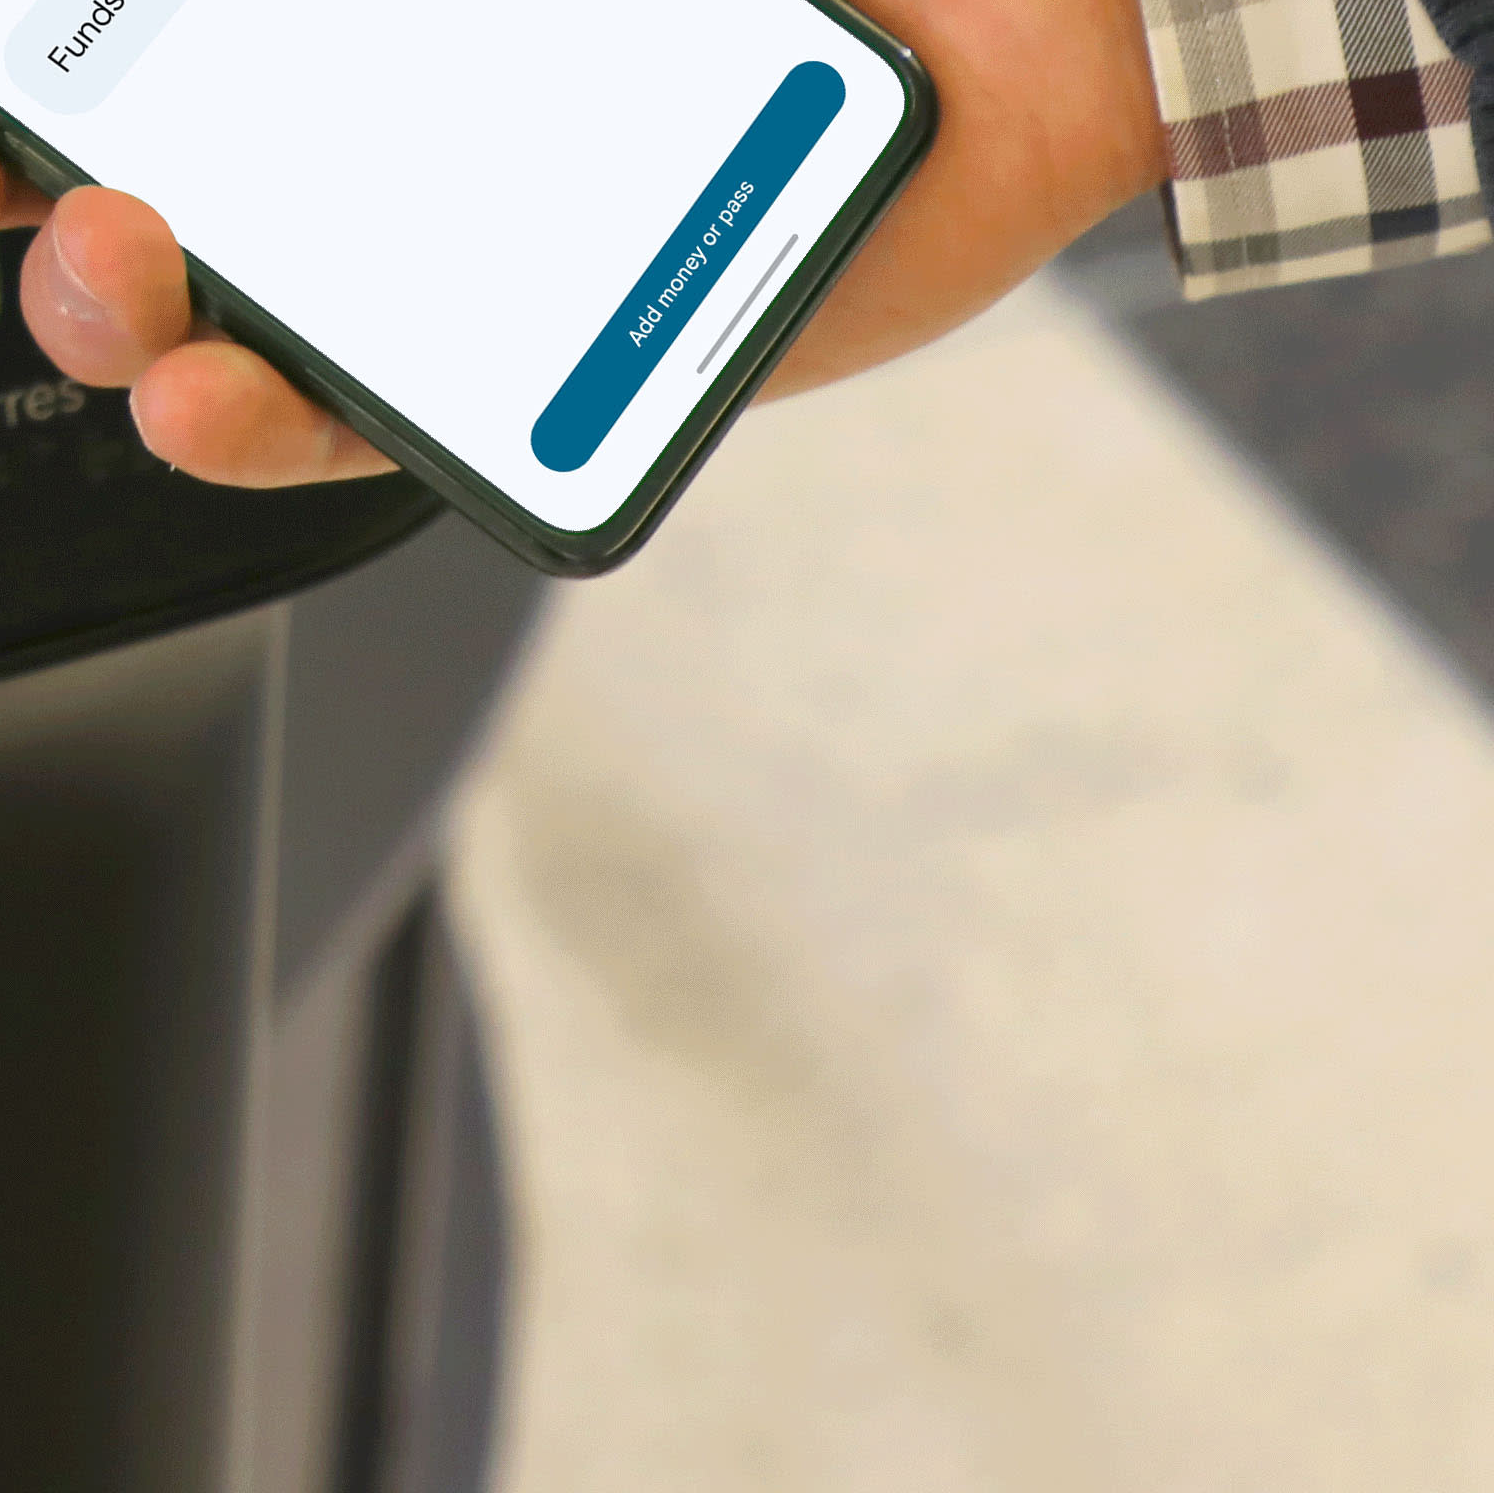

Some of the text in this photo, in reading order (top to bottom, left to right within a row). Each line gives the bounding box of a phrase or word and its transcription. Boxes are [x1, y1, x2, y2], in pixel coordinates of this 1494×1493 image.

[628, 181, 755, 348] Add money or pass
